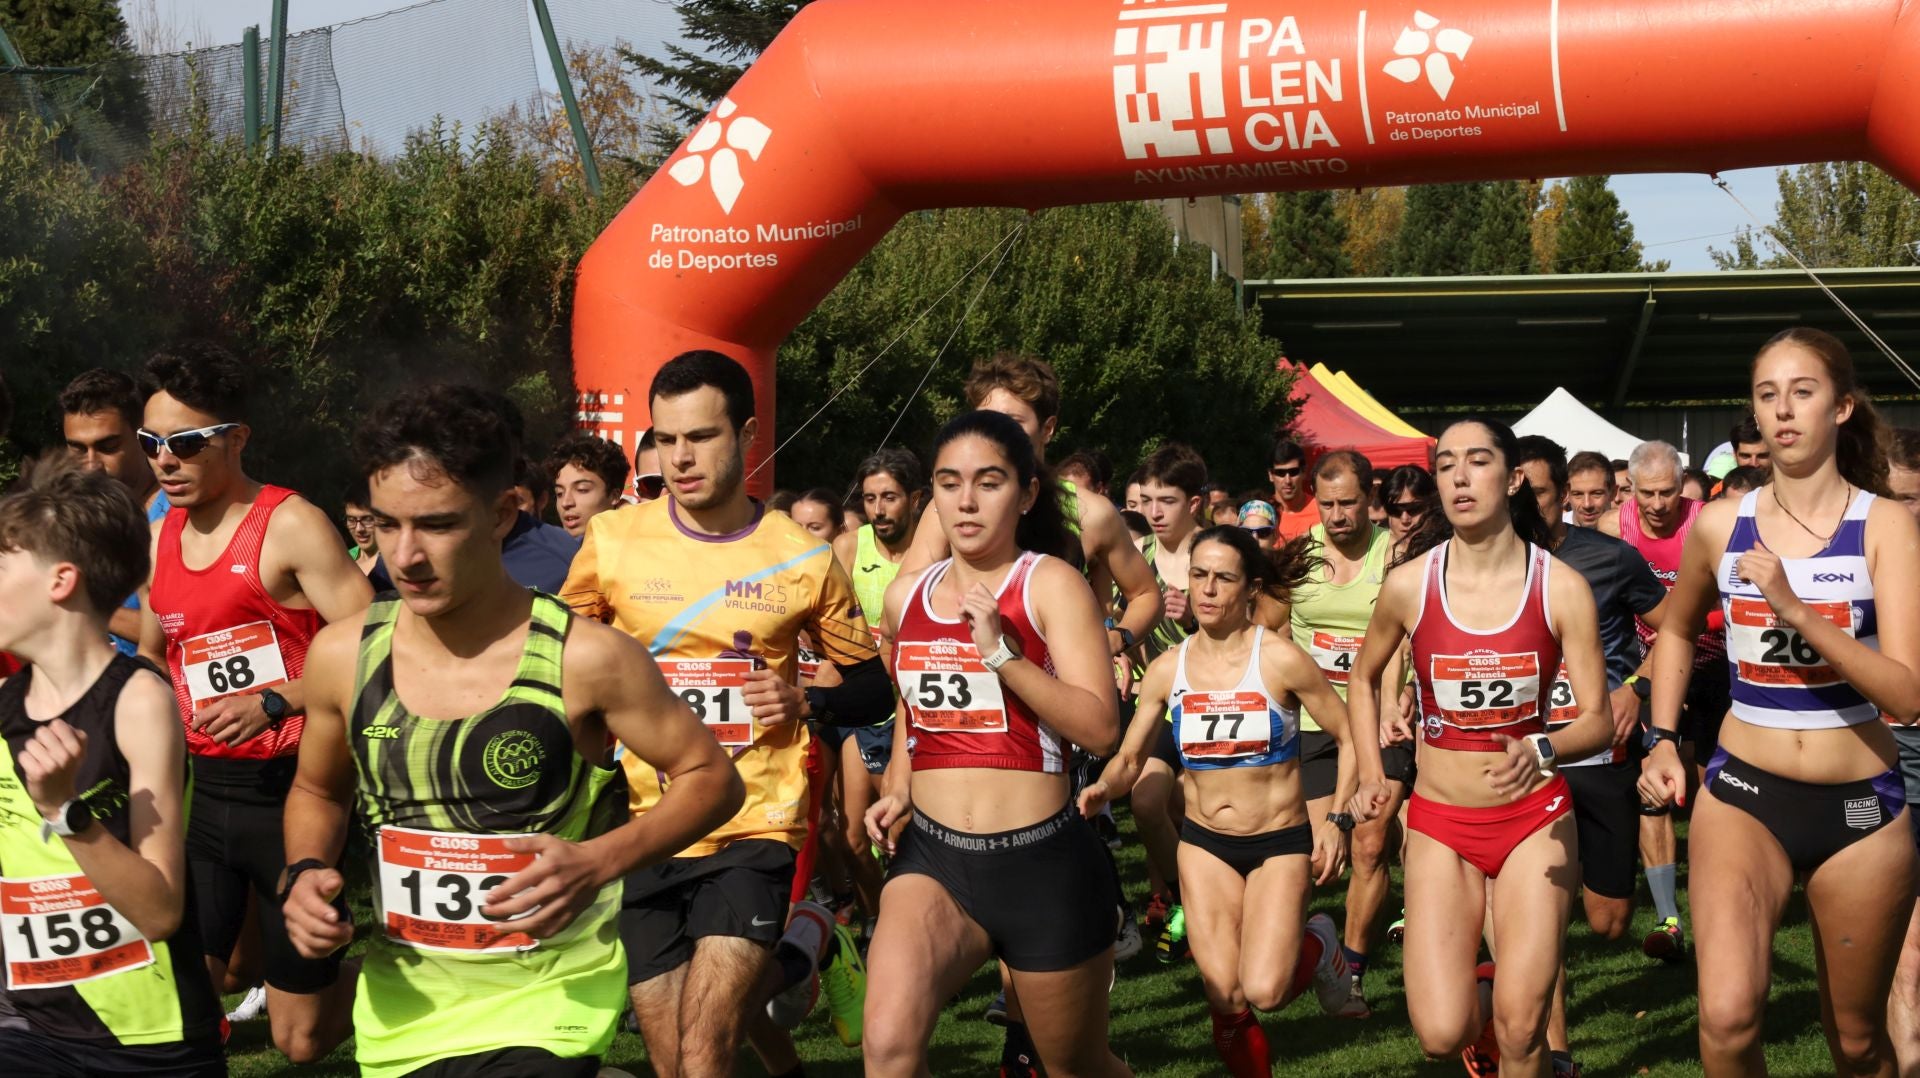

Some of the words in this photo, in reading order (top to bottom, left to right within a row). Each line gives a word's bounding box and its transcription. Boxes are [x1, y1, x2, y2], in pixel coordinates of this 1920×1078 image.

[1239, 16, 1306, 58] PA
[1239, 58, 1342, 107] LEN
[1386, 109, 1461, 125] Patronato
[1465, 101, 1540, 119] Municipal
[1244, 110, 1340, 151] CIA
[1390, 129, 1409, 141] de
[1412, 126, 1482, 141] Deportes
[1134, 157, 1349, 184] AYUNTAMIENTO
[650, 223, 750, 244] Patronato
[756, 215, 862, 243] Municipal
[648, 249, 673, 269] de
[678, 249, 778, 273] Deportes
[725, 600, 786, 615] VALLADOLID
[929, 645, 957, 655] CROSS
[1760, 629, 1821, 665] 26
[676, 663, 712, 671] CROSS
[924, 661, 963, 671] Palencia
[1468, 658, 1500, 666] CROSS
[208, 655, 255, 693] 68
[672, 678, 717, 686] Palencia
[1465, 671, 1507, 679] Palencia
[919, 673, 972, 708] 53
[1460, 680, 1514, 709] 52
[362, 726, 400, 738] 42K
[1201, 713, 1245, 740] 77
[1847, 799, 1877, 809] RACING
[430, 837, 479, 850] CROSS
[944, 834, 987, 851] ARMOUR
[1012, 823, 1057, 847] ARMOUR
[424, 856, 487, 871] Palencia
[29, 879, 72, 893] CROSS
[28, 898, 84, 913] Palencia
[18, 907, 121, 959] 158
